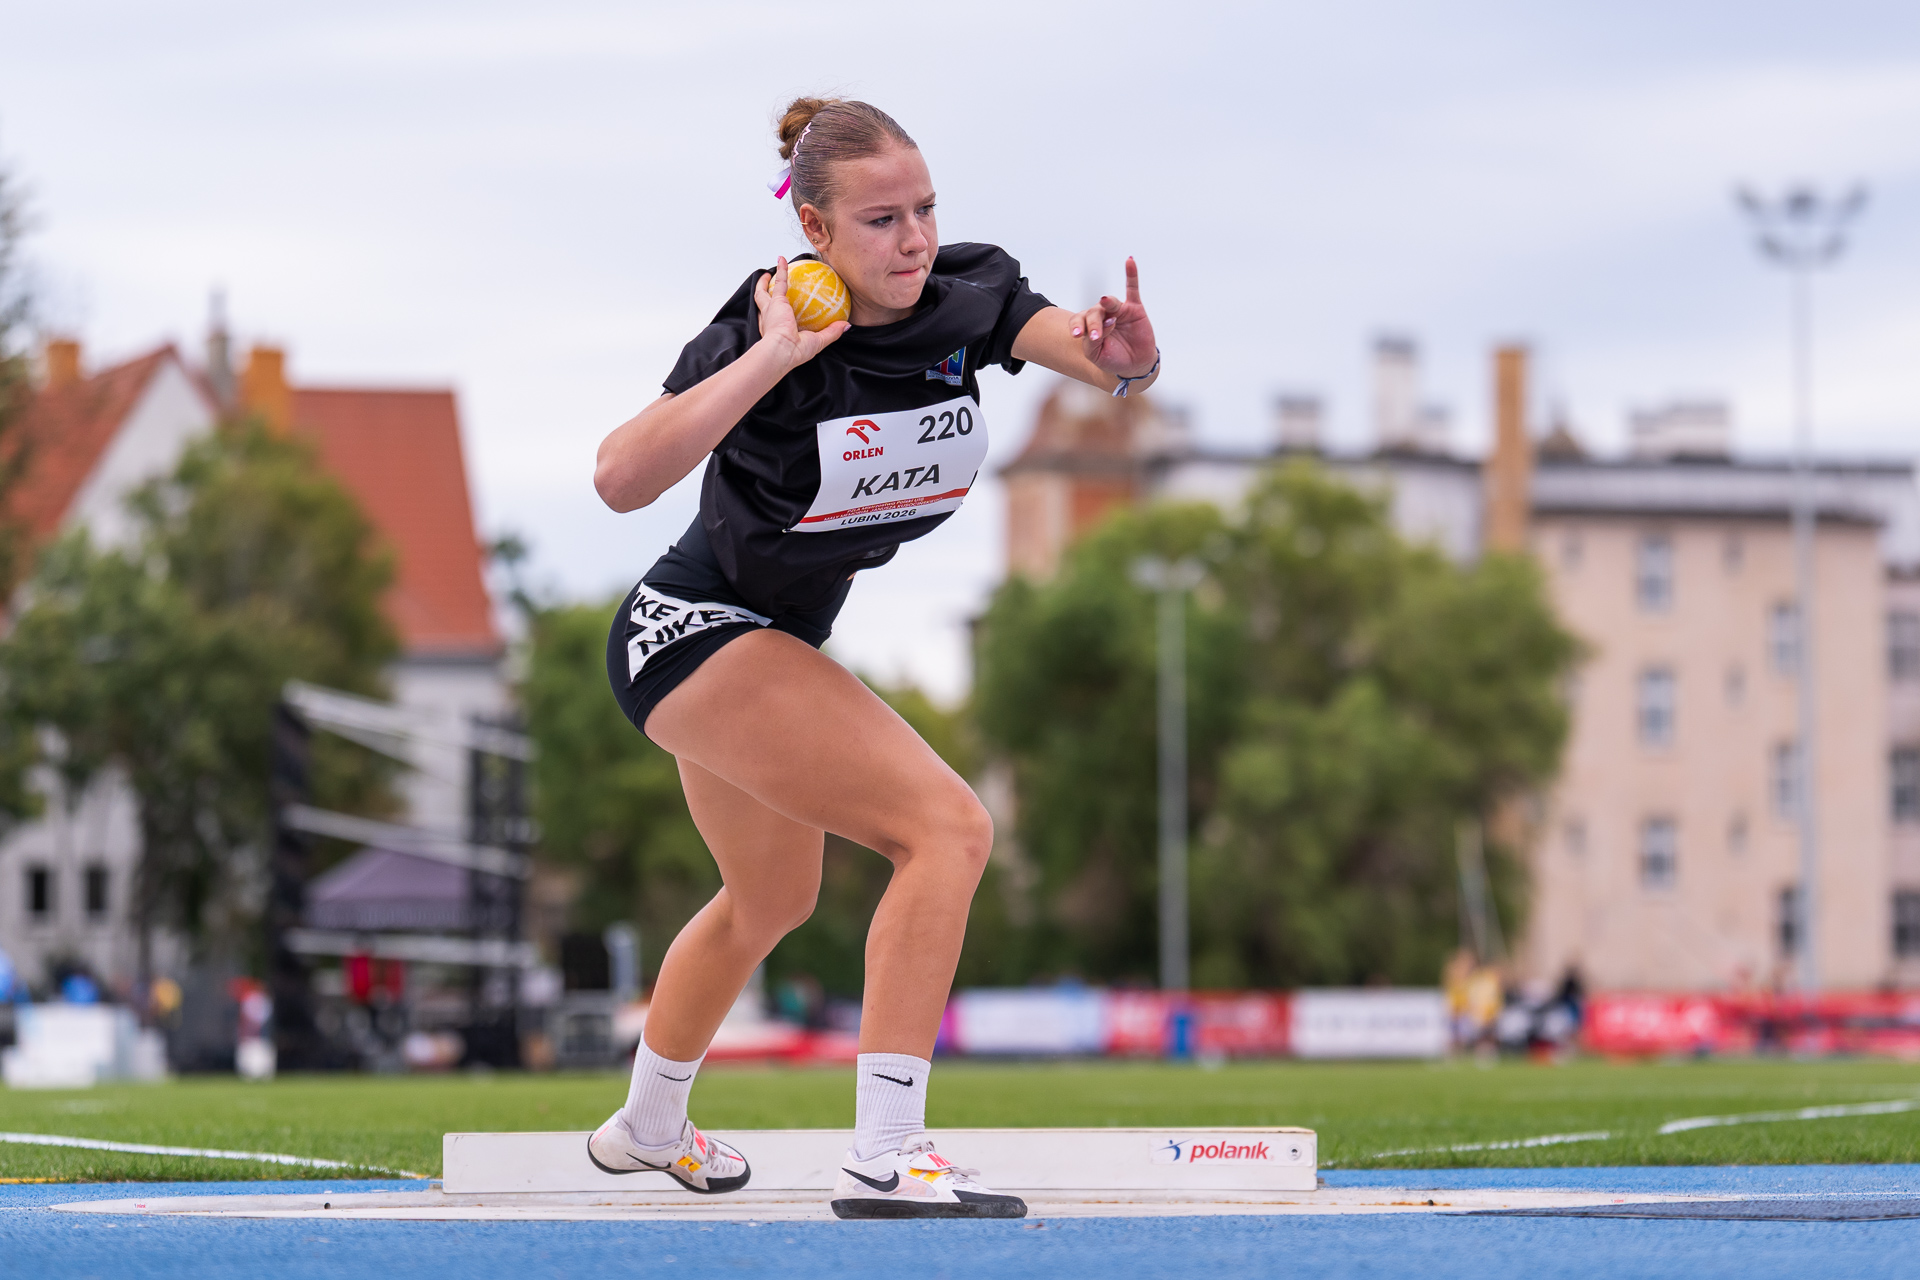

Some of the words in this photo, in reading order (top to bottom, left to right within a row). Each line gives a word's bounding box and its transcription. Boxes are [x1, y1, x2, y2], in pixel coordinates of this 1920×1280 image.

[917, 406, 973, 444] 220
[842, 446, 884, 461] ORLEN
[850, 463, 940, 499] KATA
[840, 513, 881, 525] LUBIN
[882, 508, 917, 519] 2026
[637, 609, 731, 656] NIKE
[1189, 1140, 1270, 1163] polanik
